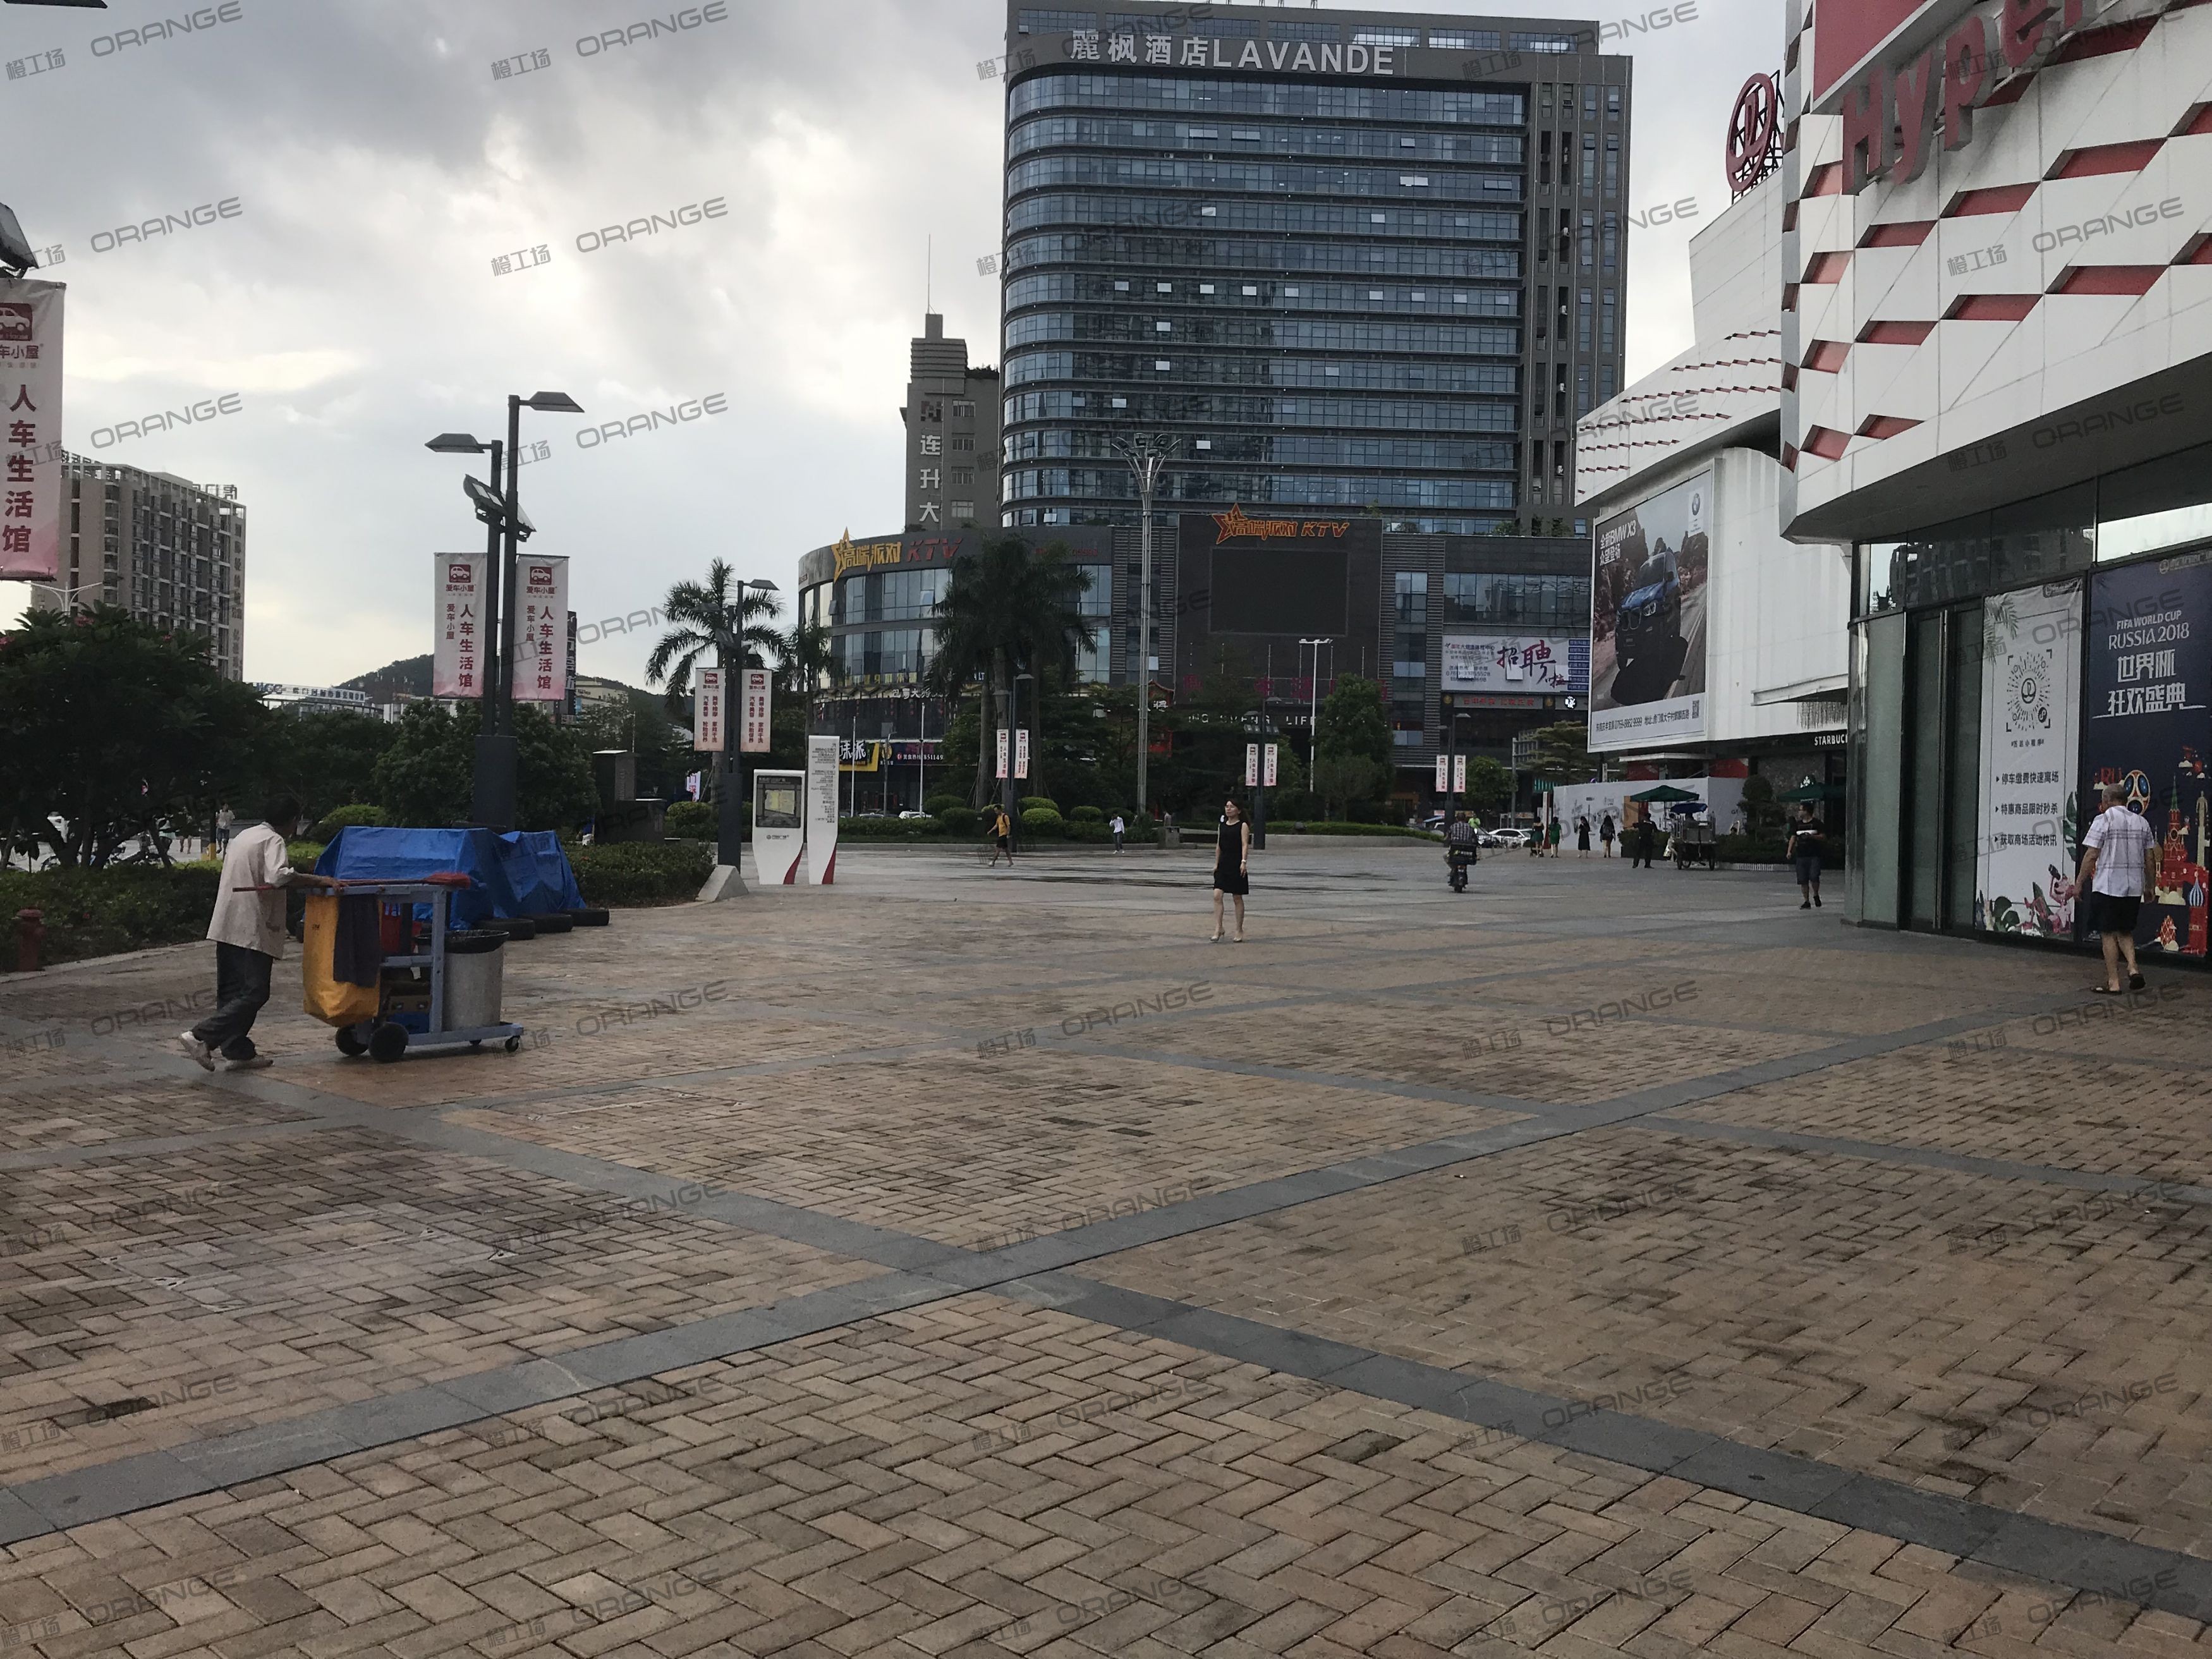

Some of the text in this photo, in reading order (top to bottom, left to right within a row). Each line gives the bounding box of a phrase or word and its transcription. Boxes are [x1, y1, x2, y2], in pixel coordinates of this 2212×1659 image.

[3, 384, 36, 554] 人车生活馆
[920, 435, 941, 522] 连升大
[1301, 522, 1350, 537] KTV
[1627, 520, 1636, 538] X3
[907, 538, 963, 562] KTV
[446, 604, 455, 640] 爱车小屋
[526, 605, 535, 641] 爱车小屋
[2117, 610, 2182, 631] FIFA WORLD CUP
[458, 604, 474, 688] 人车生活馆
[537, 605, 554, 689] 人车生活馆
[2109, 623, 2190, 650] RUSSIA 2018
[2118, 649, 2176, 683] 世界杯
[2108, 683, 2187, 717] 狂欢盛典
[2002, 770, 2059, 785] 停车缴费快速离场
[2001, 803, 2058, 815] 特惠商品限时秒杀
[2000, 834, 2057, 846] 获取商场活动快讯
